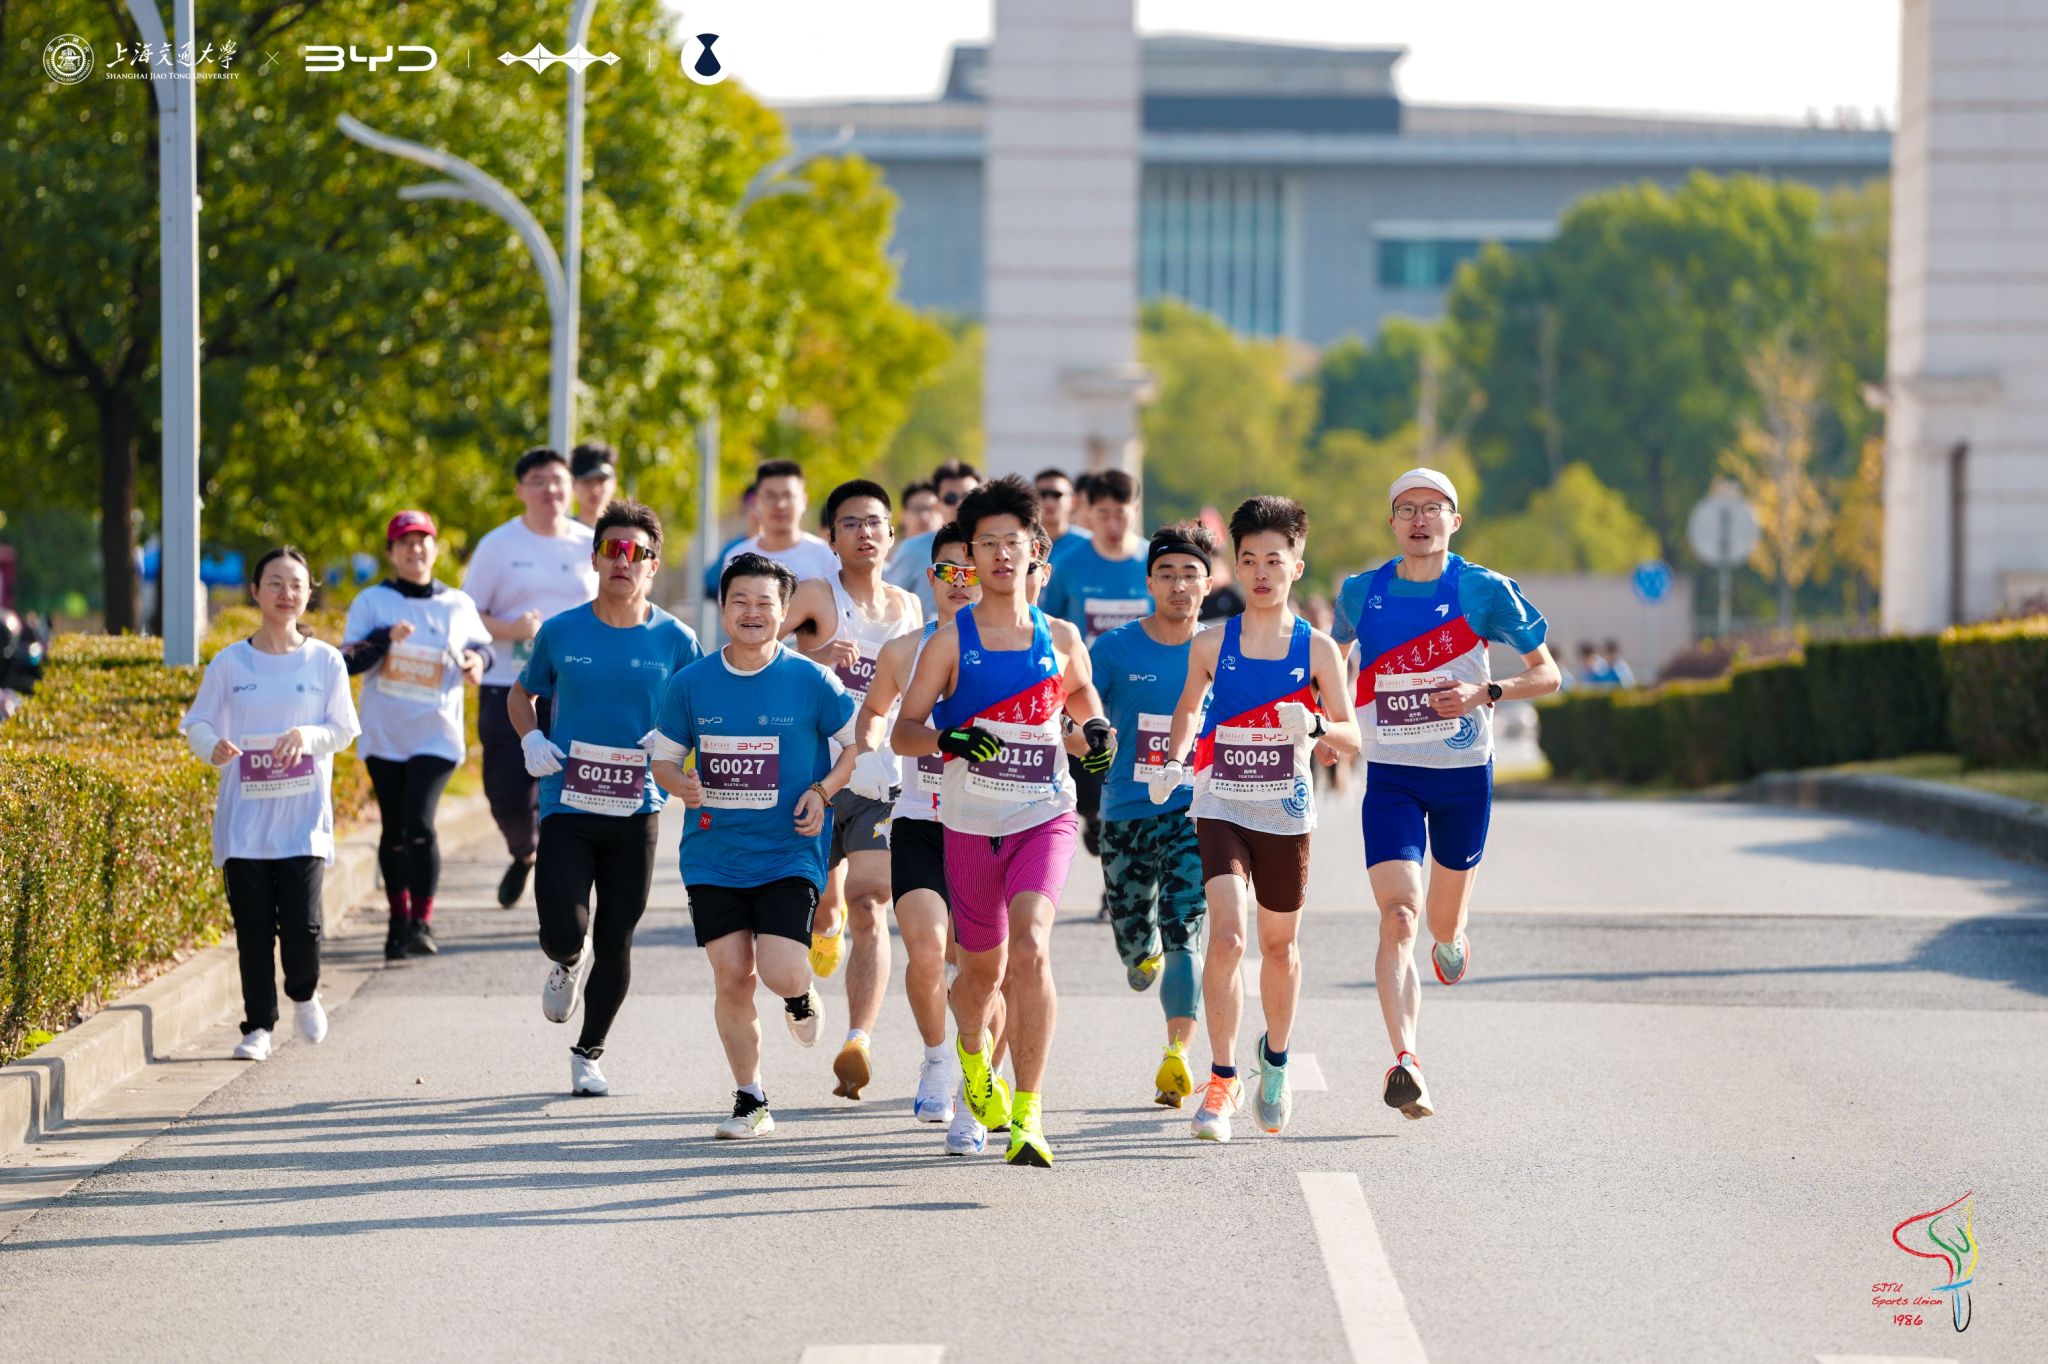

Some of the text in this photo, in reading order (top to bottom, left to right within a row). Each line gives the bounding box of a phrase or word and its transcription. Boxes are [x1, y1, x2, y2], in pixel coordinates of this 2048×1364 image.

[564, 655, 592, 664] BYD
[1128, 674, 1157, 682] BYD
[1411, 676, 1448, 686] BYD
[1387, 693, 1431, 711] G014
[697, 716, 723, 725] BYD
[1019, 731, 1054, 741] BYD
[1251, 733, 1289, 742] BYD
[737, 742, 774, 751] BYD
[610, 752, 644, 763] BYD
[987, 747, 1044, 767] 0116
[1224, 749, 1281, 766] G0049
[709, 758, 765, 775] G0027
[578, 764, 634, 785] G0113
